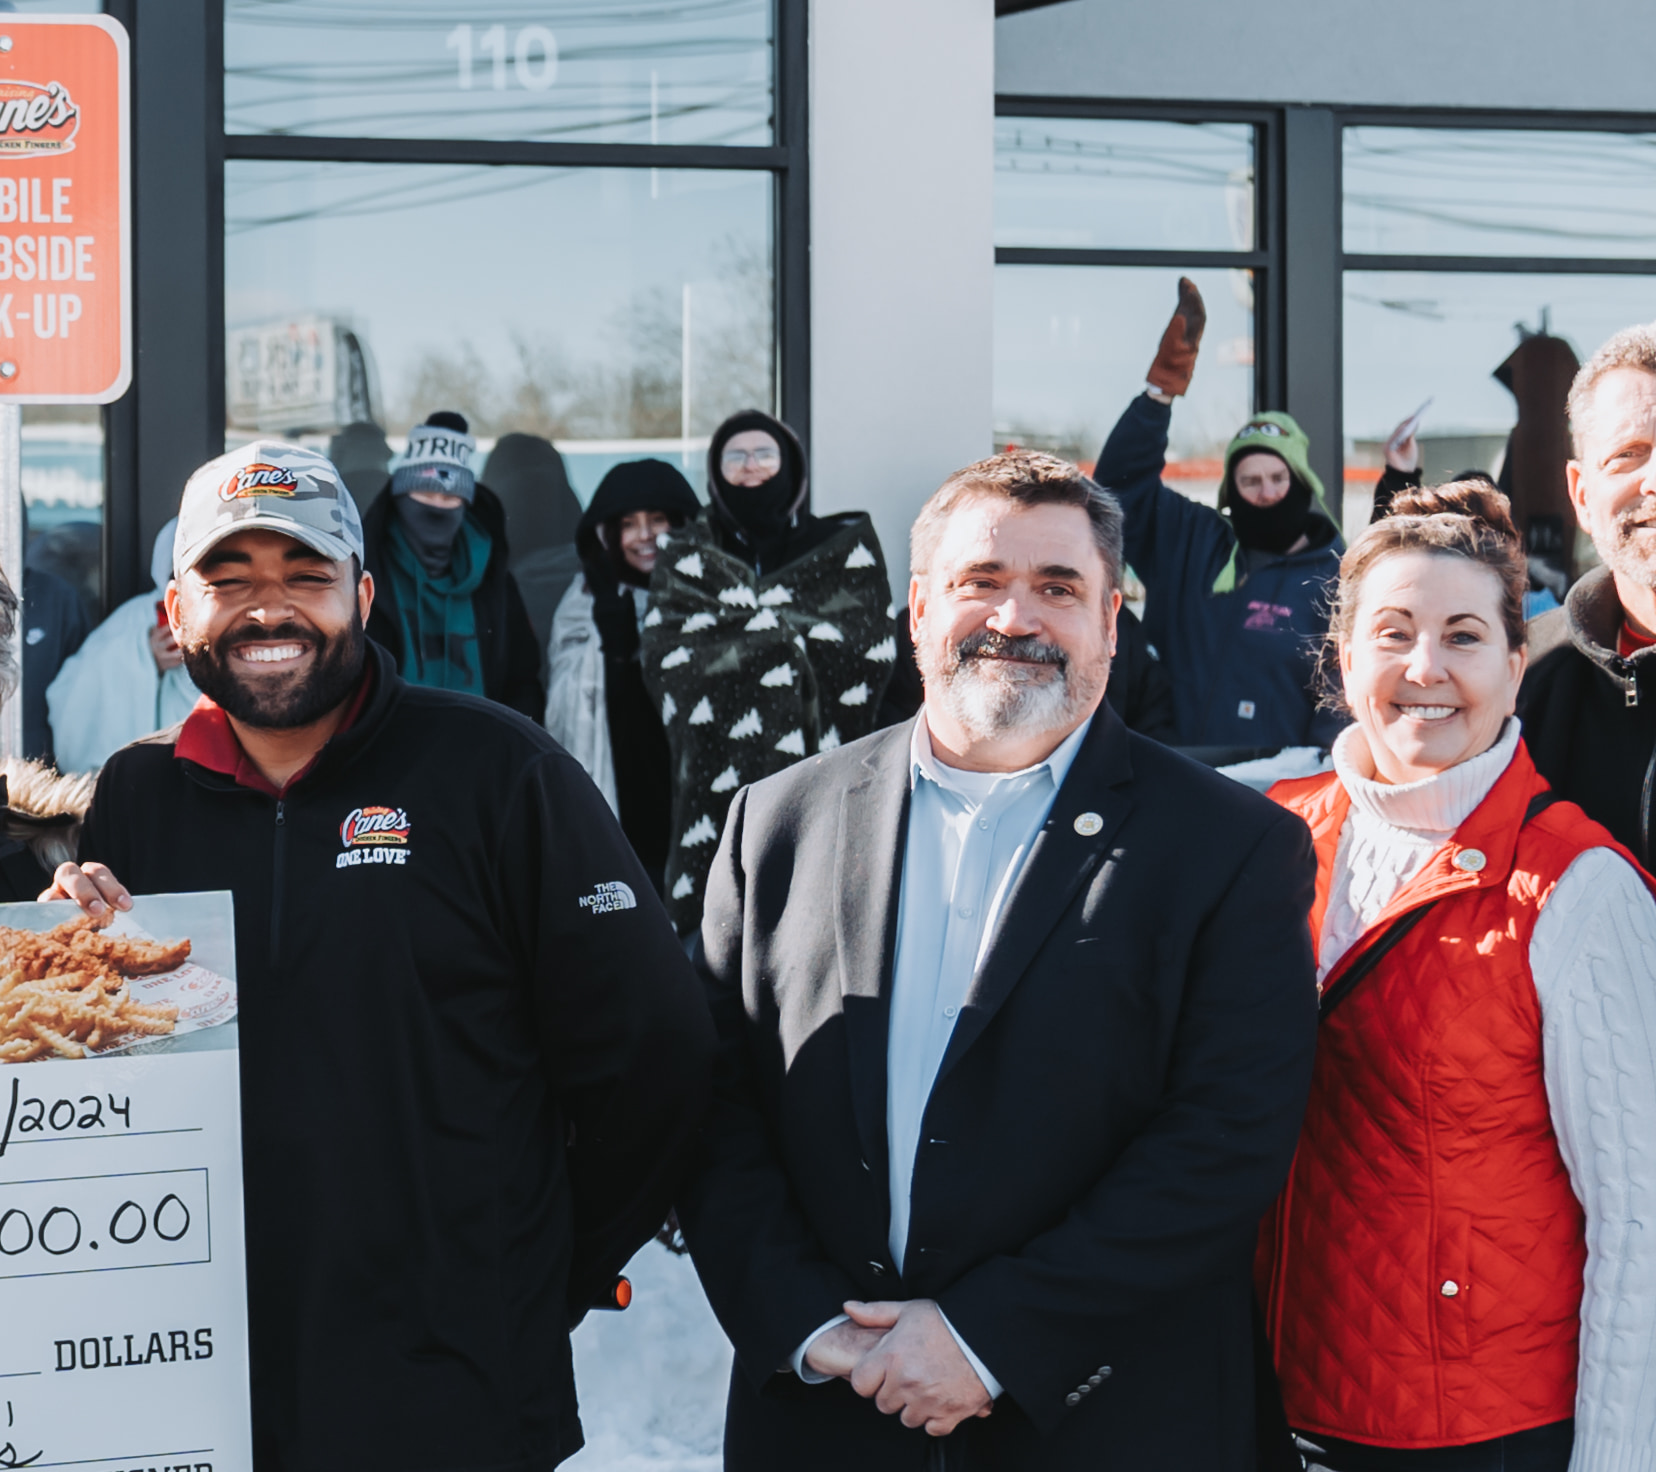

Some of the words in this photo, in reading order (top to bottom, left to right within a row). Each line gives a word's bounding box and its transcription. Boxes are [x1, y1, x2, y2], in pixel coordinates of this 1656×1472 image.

[445, 23, 560, 92] 110
[220, 467, 297, 502] Cane's
[341, 807, 412, 848] Cane's
[335, 848, 362, 869] ONE
[363, 847, 407, 865] LOVE
[578, 891, 618, 908] NORTH
[593, 882, 617, 894] THE
[592, 901, 622, 915] FACE
[54, 1327, 215, 1372] DOLLARS
